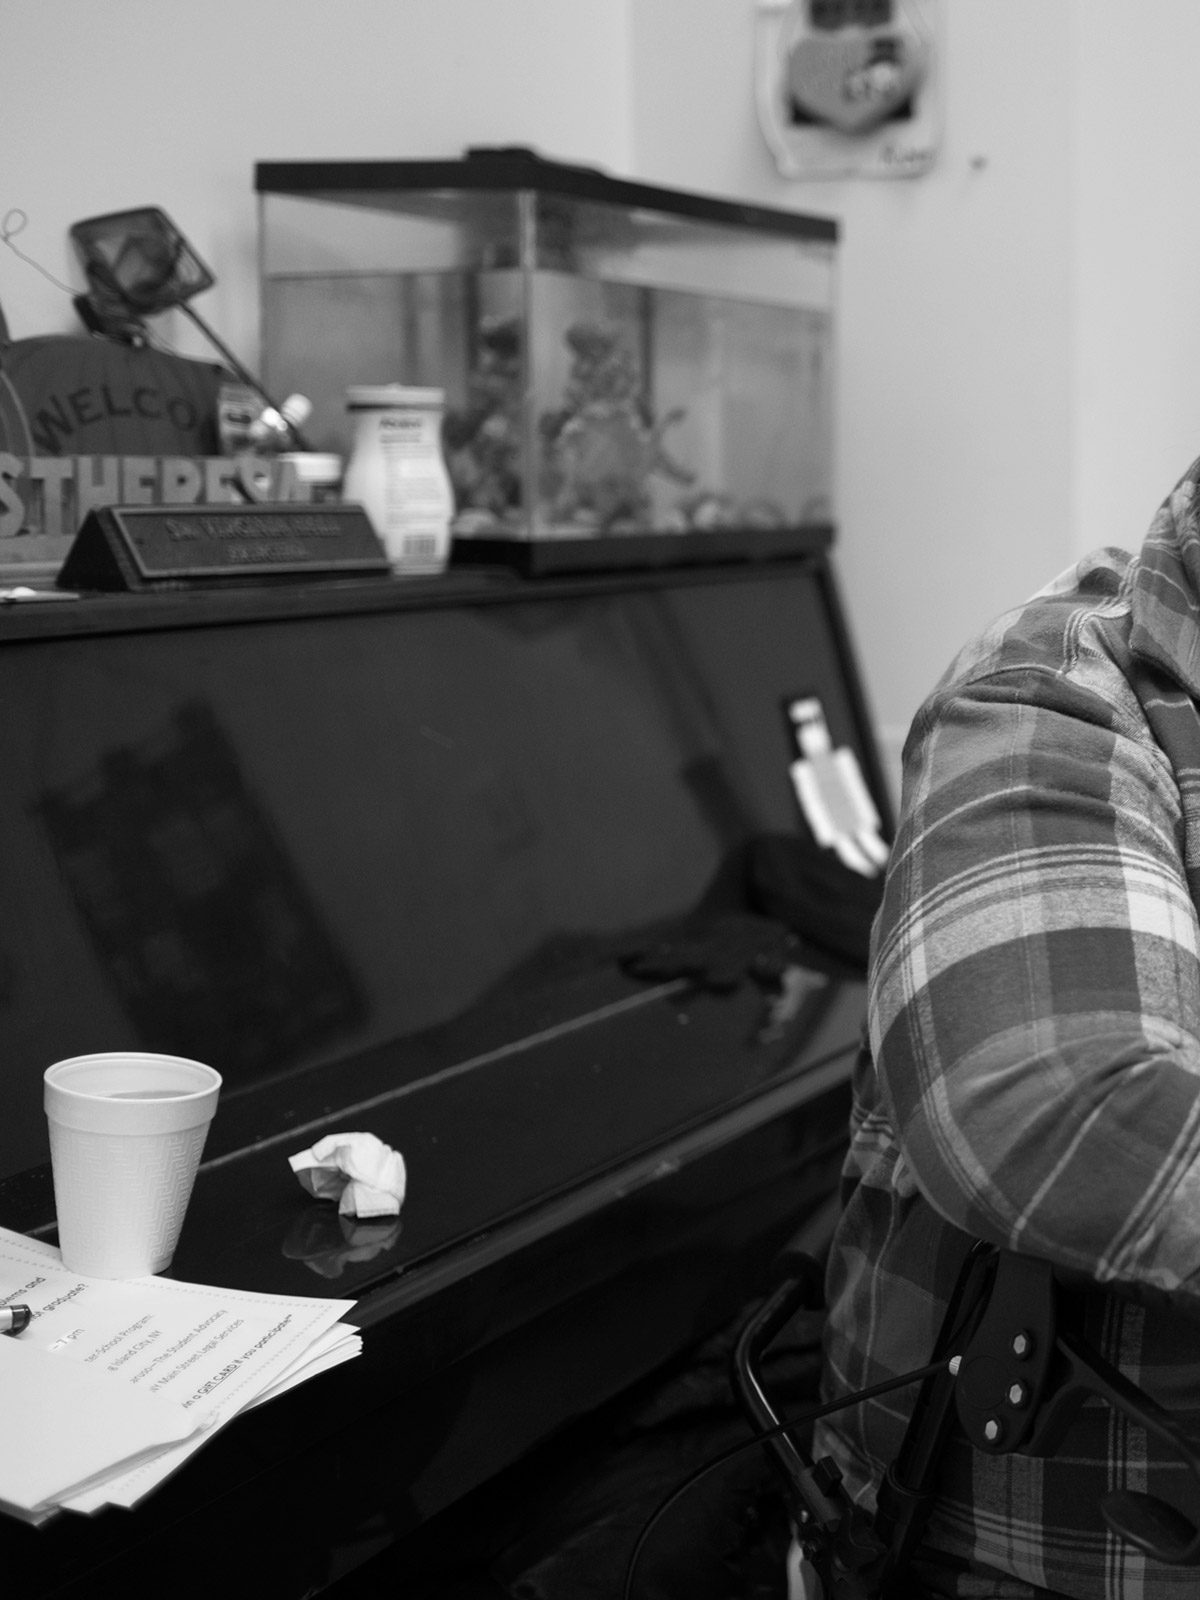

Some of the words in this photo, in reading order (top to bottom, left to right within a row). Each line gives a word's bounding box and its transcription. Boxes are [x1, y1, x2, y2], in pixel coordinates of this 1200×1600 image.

[33, 384, 197, 454] WELCO
[25, 1276, 47, 1289] and
[42, 1283, 89, 1311] graduate?
[66, 1328, 85, 1340] pm
[166, 1333, 198, 1353] Student
[193, 1309, 228, 1333] Advocacy
[111, 1349, 137, 1366] Island
[157, 1370, 181, 1384] Main
[175, 1353, 203, 1371] Street
[196, 1339, 219, 1355] Legal
[213, 1318, 244, 1340] Services
[197, 1381, 217, 1394] GIFT
[213, 1364, 237, 1381] CARD
[240, 1348, 257, 1360] you
